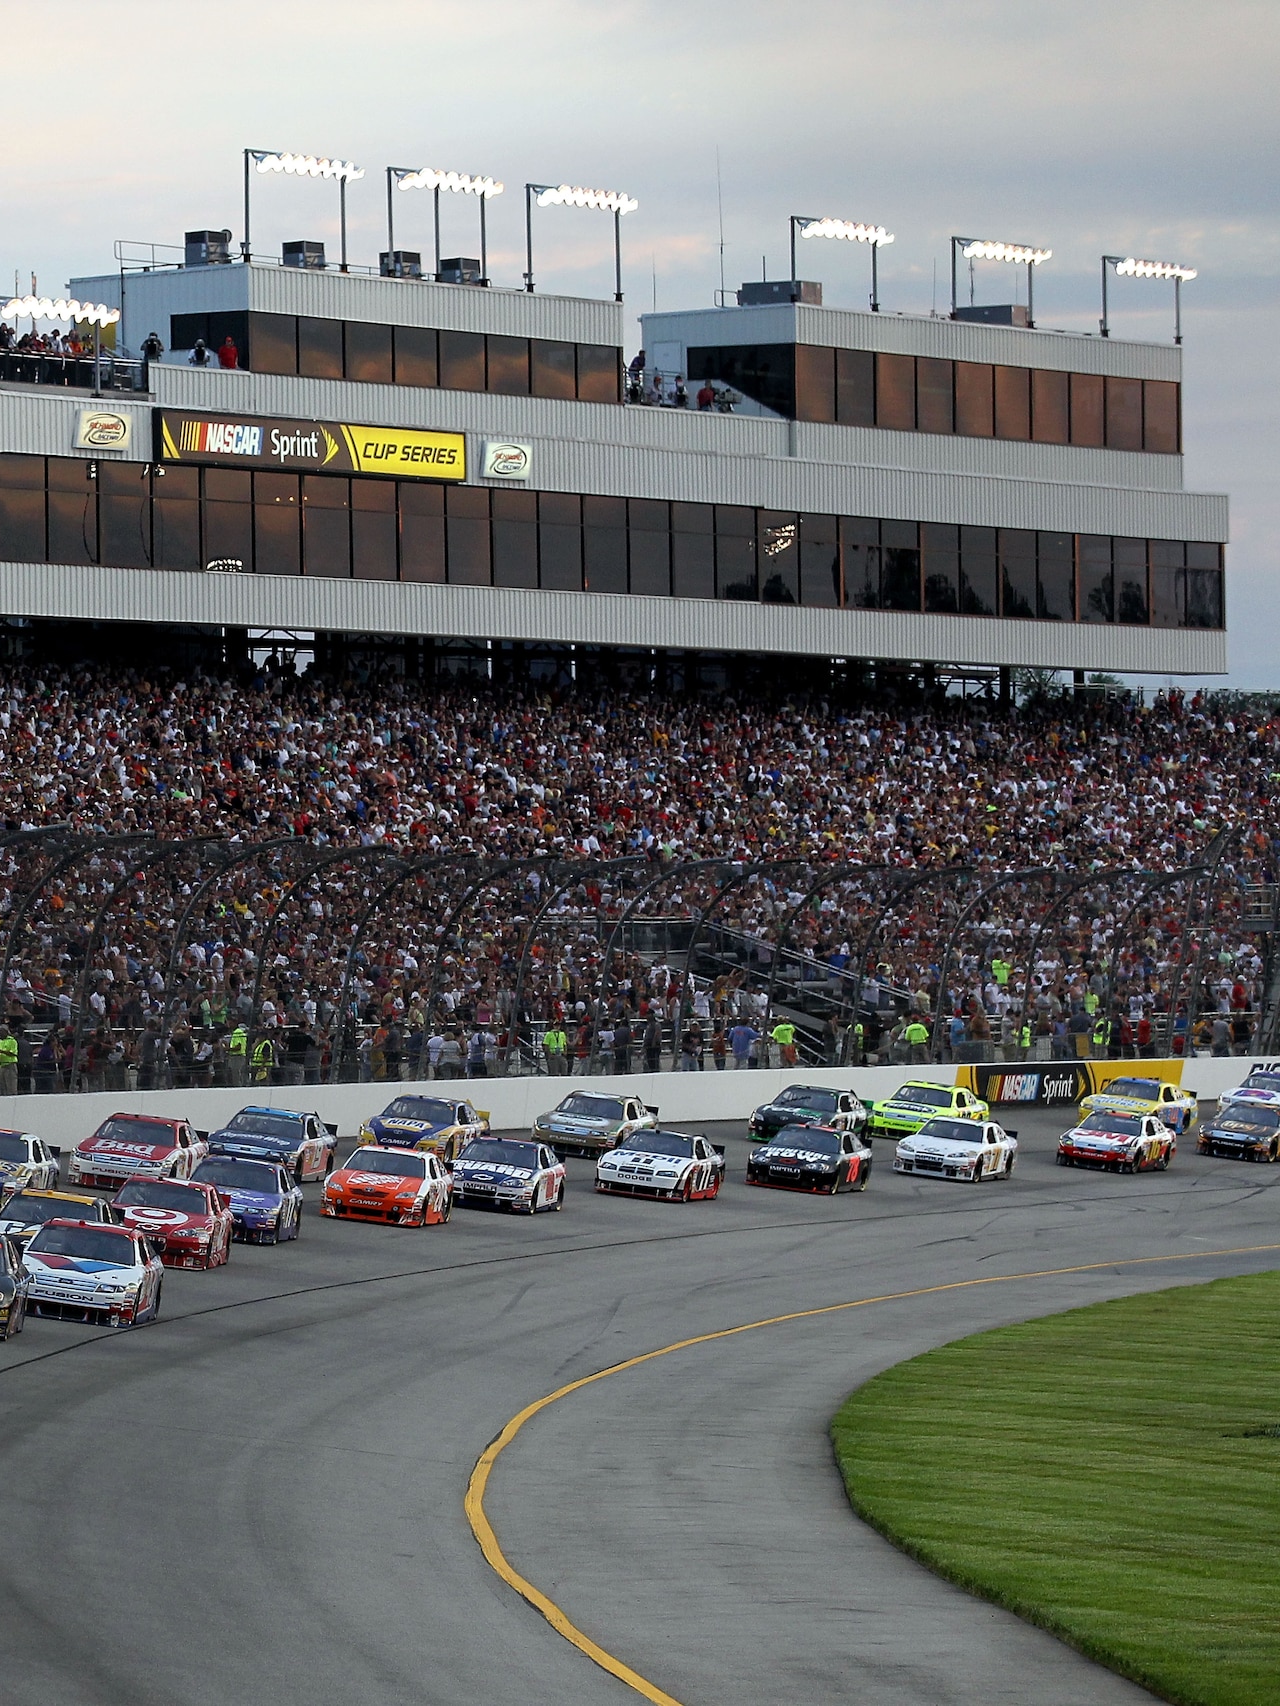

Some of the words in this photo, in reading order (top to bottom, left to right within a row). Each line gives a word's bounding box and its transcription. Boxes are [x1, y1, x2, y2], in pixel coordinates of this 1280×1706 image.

[205, 422, 260, 456] NASCAR
[270, 428, 319, 463] Sprint
[362, 442, 397, 460] CUP
[400, 445, 458, 465] SERIES
[1001, 1074, 1038, 1101] NASCAR
[1041, 1074, 1073, 1104] Sprint
[387, 1118, 427, 1129] NAPA
[91, 1139, 156, 1156] Bud
[380, 1137, 411, 1146] CAMRY
[617, 1172, 653, 1182] DODGE
[34, 1288, 94, 1302] FUSION
